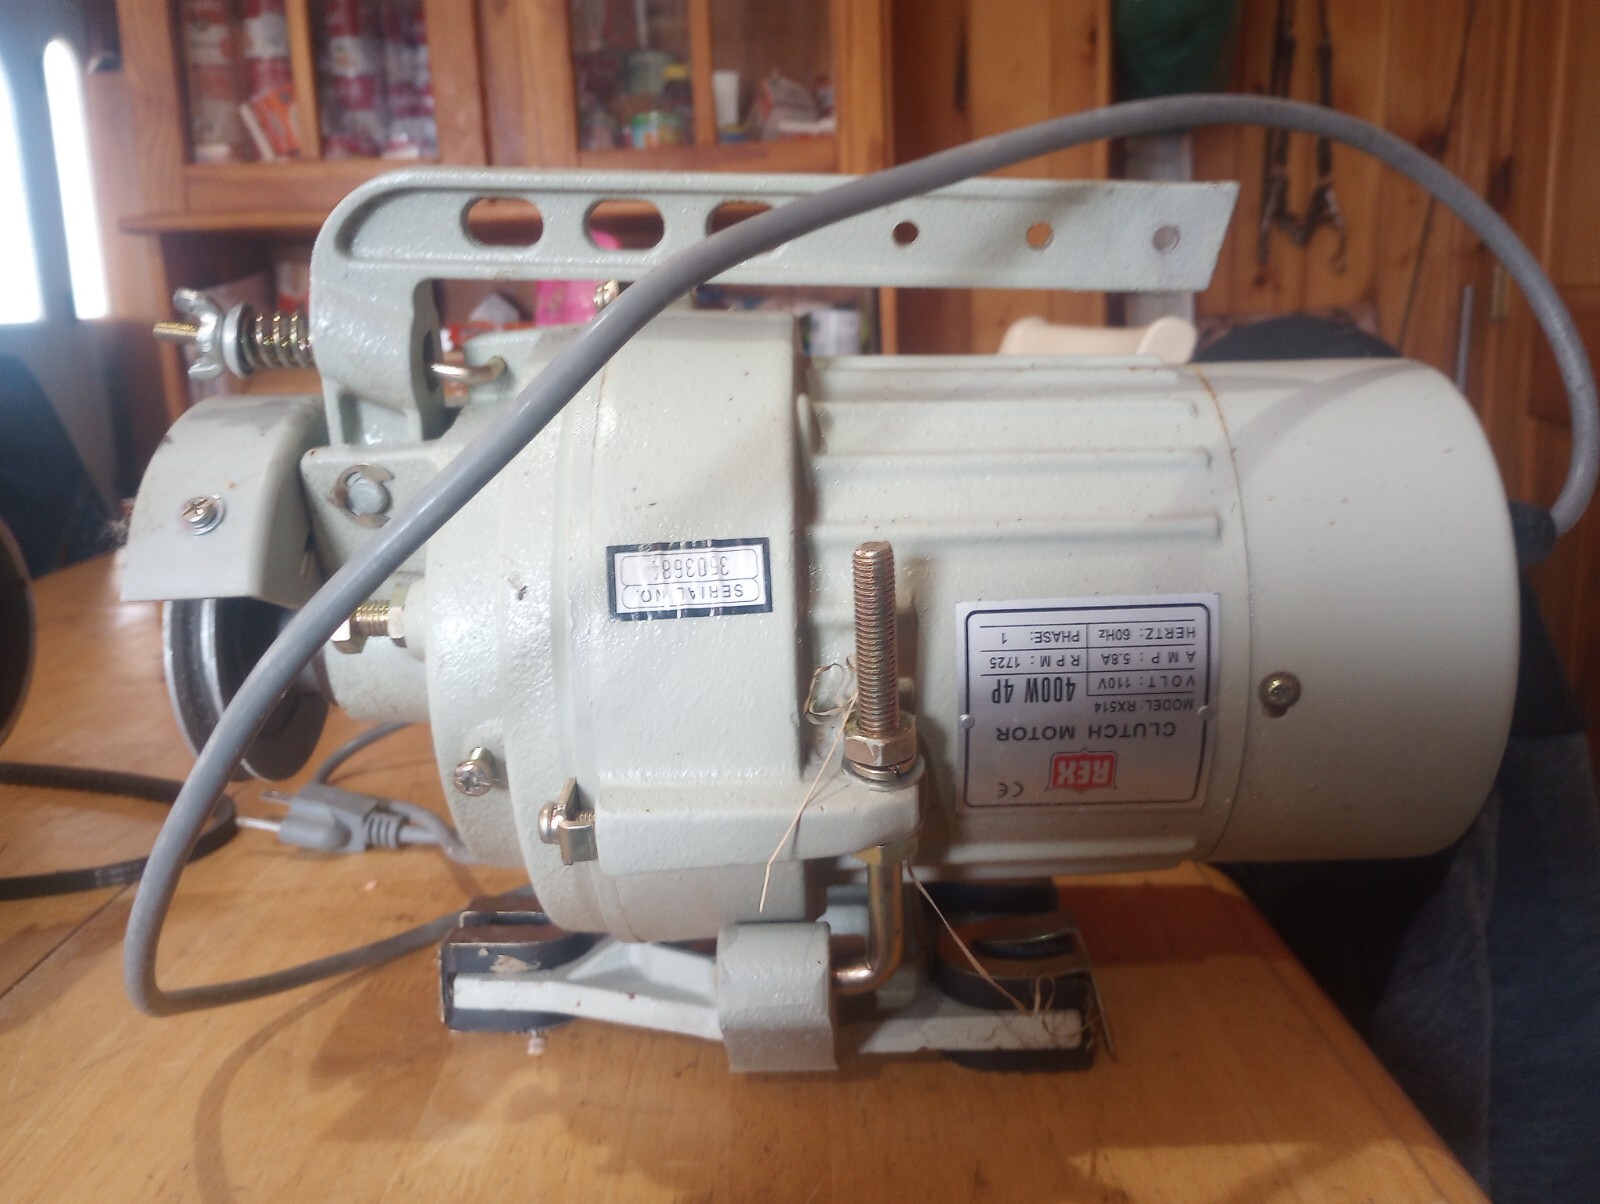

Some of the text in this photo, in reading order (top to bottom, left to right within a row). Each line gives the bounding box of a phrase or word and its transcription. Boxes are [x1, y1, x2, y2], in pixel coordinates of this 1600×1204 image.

[1001, 630, 1080, 645] PHASE: 1
[1098, 627, 1131, 641] 60Hz
[989, 656, 1021, 670] 1725
[1101, 652, 1131, 665] 5.8A
[991, 676, 1077, 704] 400W 4P
[1098, 676, 1132, 690] 110V
[1094, 700, 1136, 713] RX514
[995, 721, 1176, 742] CLUTCH MOTOR
[1056, 759, 1111, 786] REX
